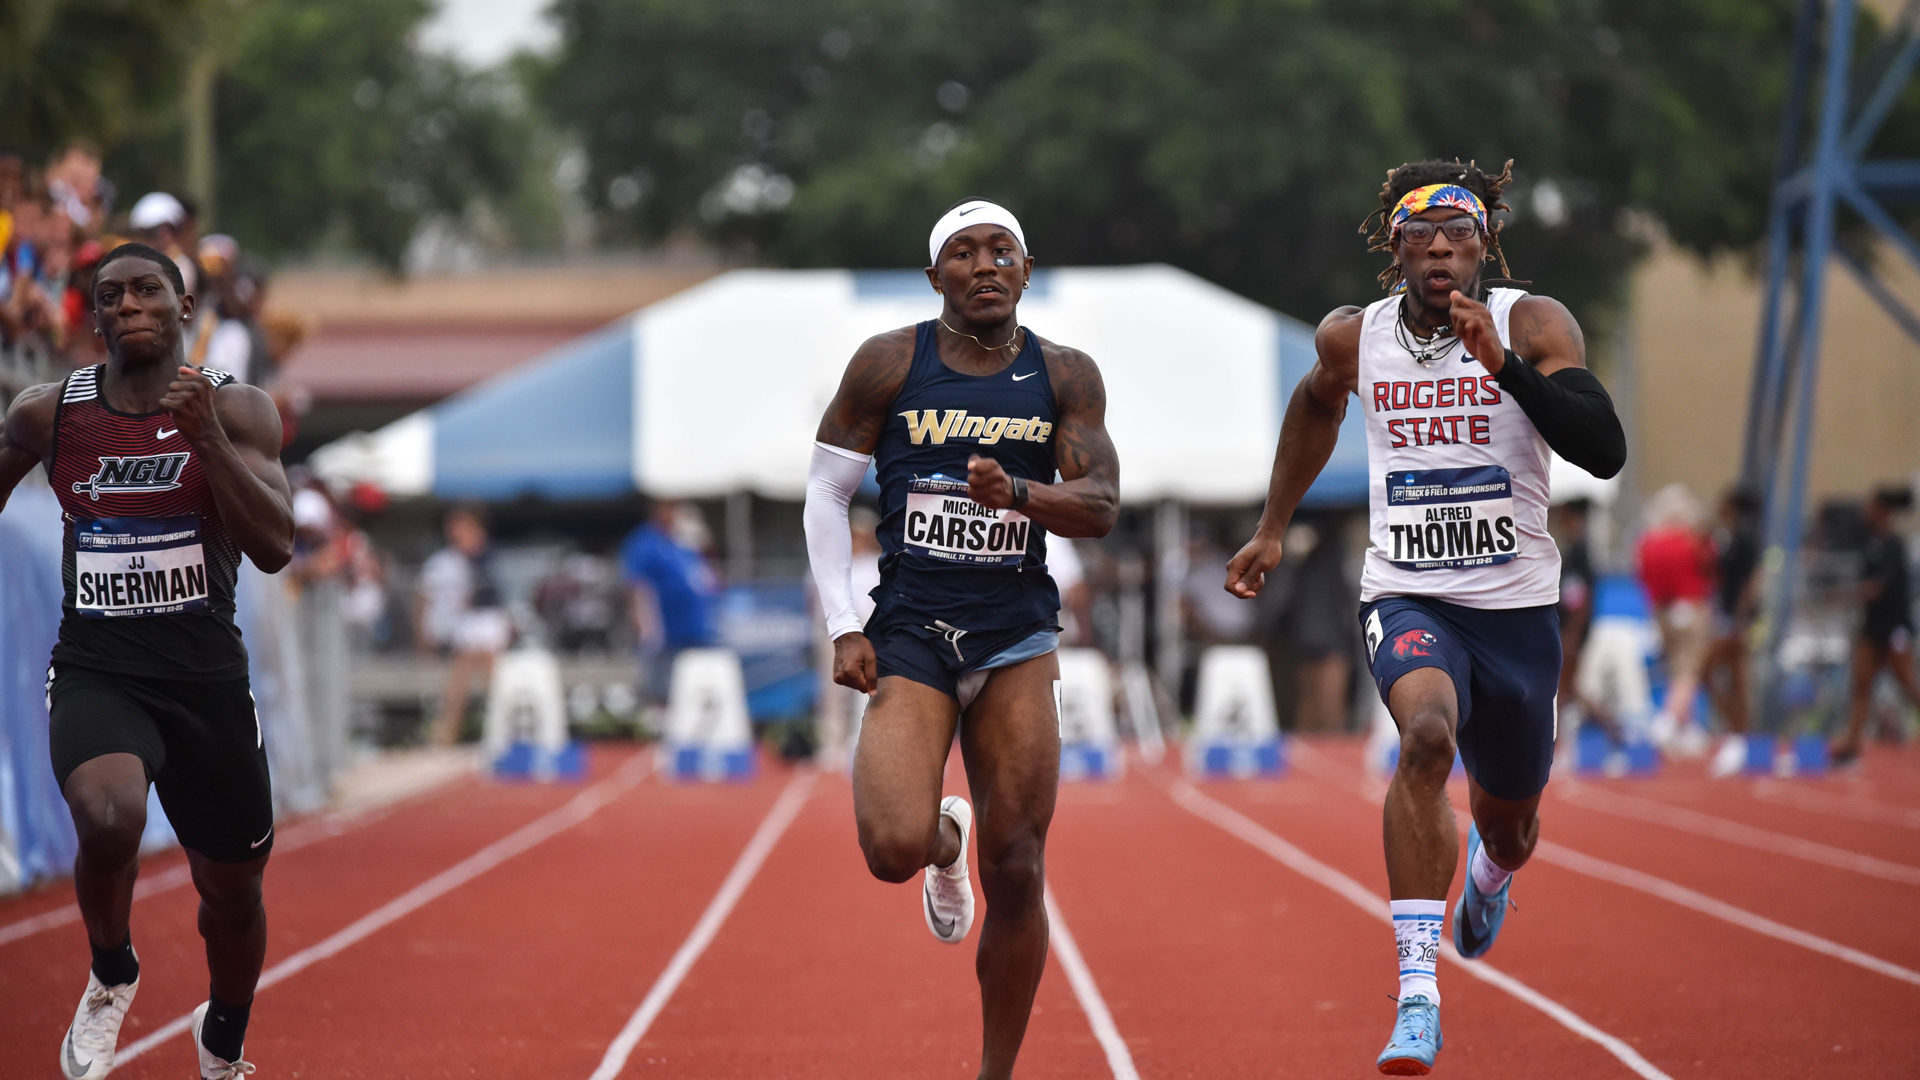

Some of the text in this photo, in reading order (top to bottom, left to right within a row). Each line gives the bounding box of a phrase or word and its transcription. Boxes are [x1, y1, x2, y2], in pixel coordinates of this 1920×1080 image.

[1373, 375, 1502, 412] ROGERS
[897, 410, 1053, 445] Wingate
[1387, 415, 1490, 448] STATE
[99, 453, 190, 484] NGU
[1405, 489, 1424, 498] TRACK
[1431, 488, 1448, 496] FIELD
[1449, 483, 1506, 495] CHAMPIONSHIPS
[942, 499, 999, 519] MICHAEL
[1425, 506, 1472, 522] ALFRED
[92, 537, 112, 545] TRACK
[118, 537, 136, 545] FIELD
[137, 530, 196, 544] CHAMPIONSHIPS
[908, 511, 1027, 551] CARSON
[1389, 516, 1516, 560] THOMAS
[128, 556, 145, 569] JJ
[80, 564, 205, 606] SHERMAN
